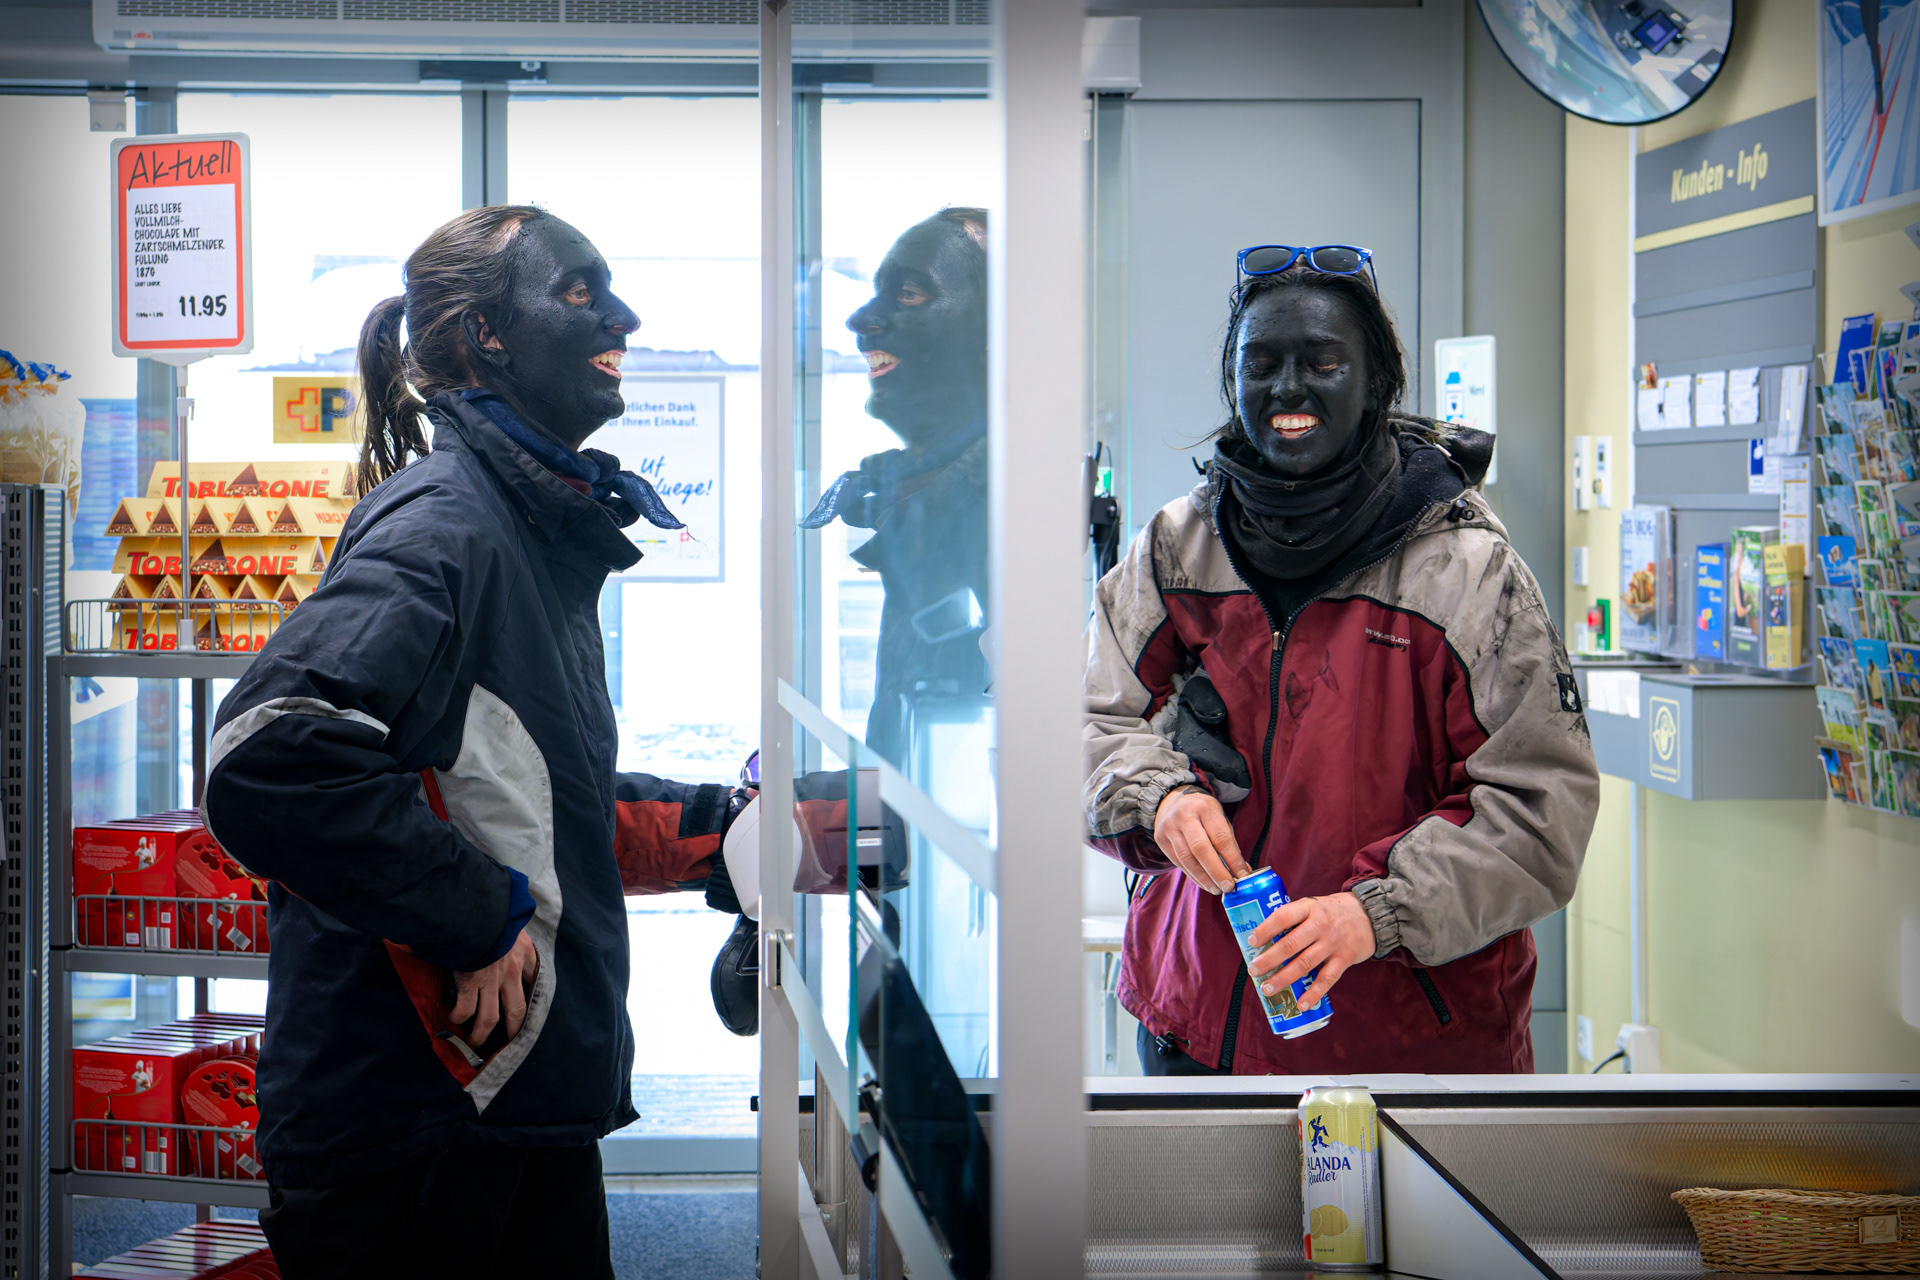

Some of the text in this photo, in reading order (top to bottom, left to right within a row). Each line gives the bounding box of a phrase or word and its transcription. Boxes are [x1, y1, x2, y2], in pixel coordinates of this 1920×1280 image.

[127, 140, 233, 191] Aktuell
[1670, 159, 1724, 203] Kunden
[1736, 143, 1769, 191] Info
[134, 202, 183, 215] ALLES LIEBE
[134, 215, 184, 228] VOLLMILCH-
[134, 226, 201, 241] CHOCOLADE MIT
[134, 239, 225, 253] ZARTSCHMELZENDER
[135, 267, 156, 278] 187G
[179, 294, 228, 318] 11.95
[625, 402, 697, 413] zlichen Dank
[622, 416, 651, 427] Ihren
[654, 416, 699, 427] Einkauf.
[162, 477, 330, 498] TOBLRONE
[653, 478, 713, 504] luege!
[127, 551, 298, 575] TOBRONE
[125, 628, 271, 651] TOBRON
[1307, 1156, 1352, 1171] ALANDA
